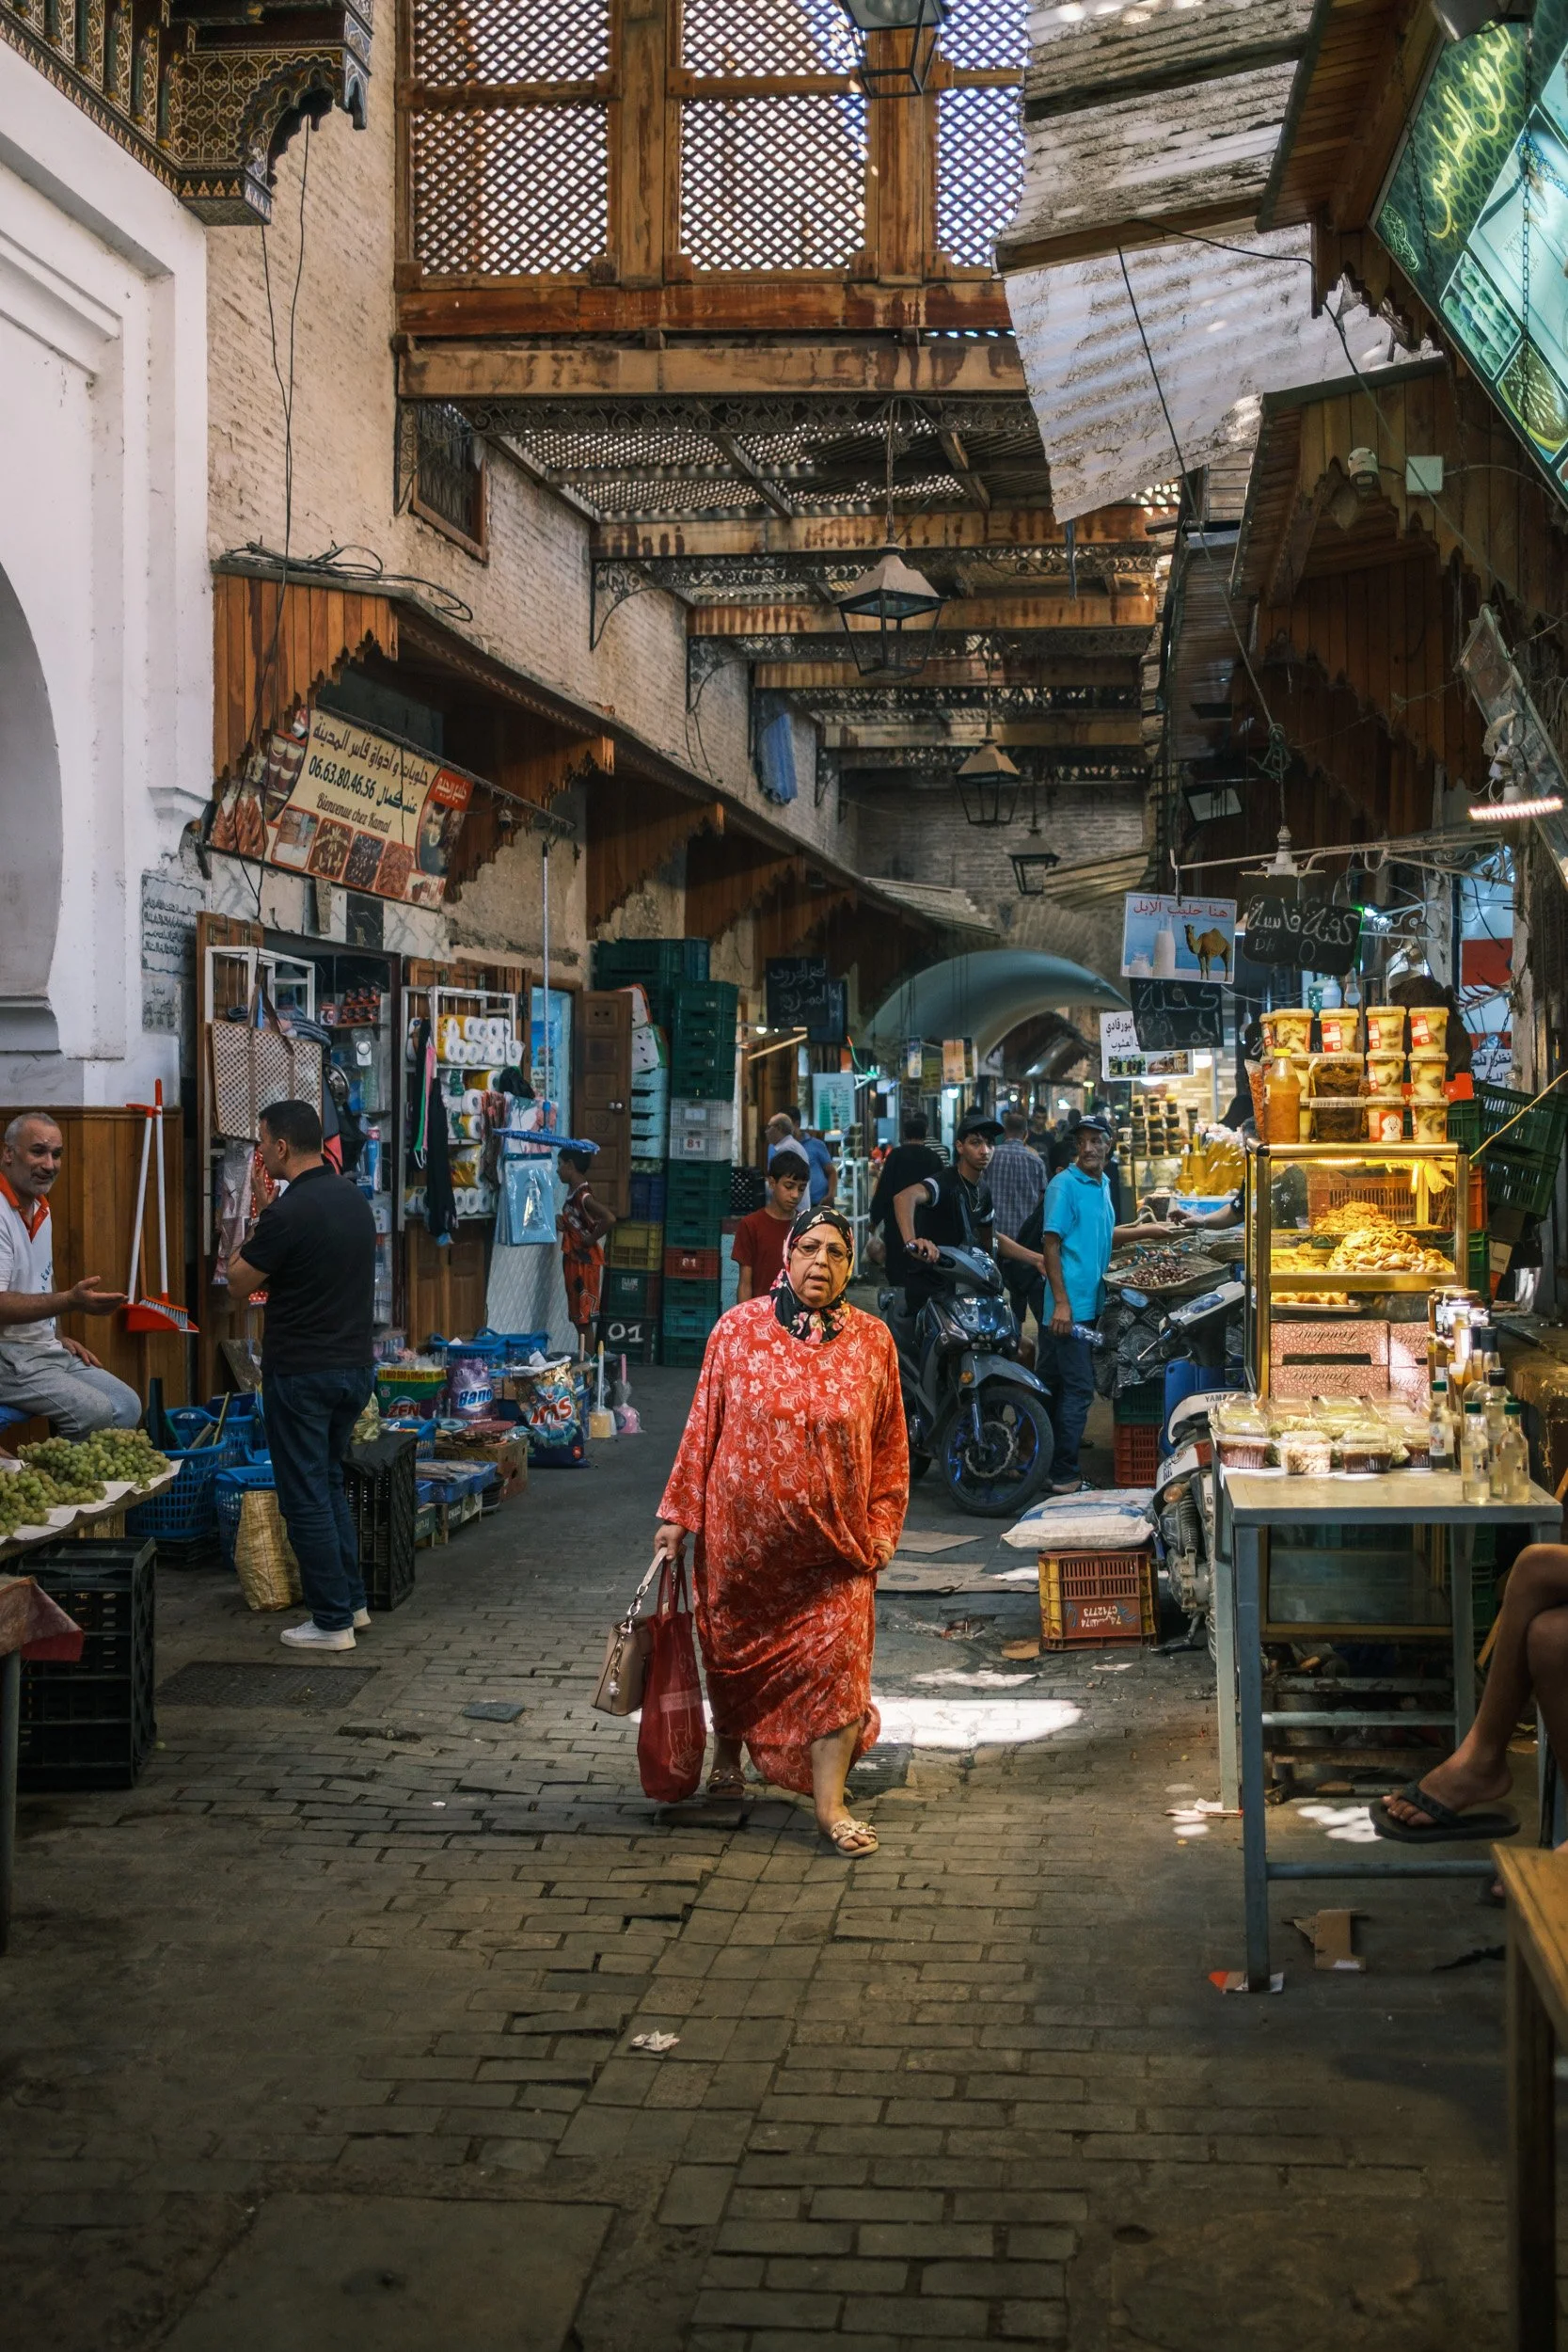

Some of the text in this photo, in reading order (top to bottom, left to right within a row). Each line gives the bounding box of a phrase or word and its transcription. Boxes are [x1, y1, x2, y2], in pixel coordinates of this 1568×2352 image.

[312, 715, 351, 752] المدينة
[348, 736, 372, 760] فاس
[309, 755, 376, 800] 06.63.80.46.56
[316, 792, 392, 834] Bienvenue chez Kamal
[1167, 902, 1203, 920] حليب
[1208, 905, 1228, 918] هنا
[387, 1403, 421, 1418] ZEN
